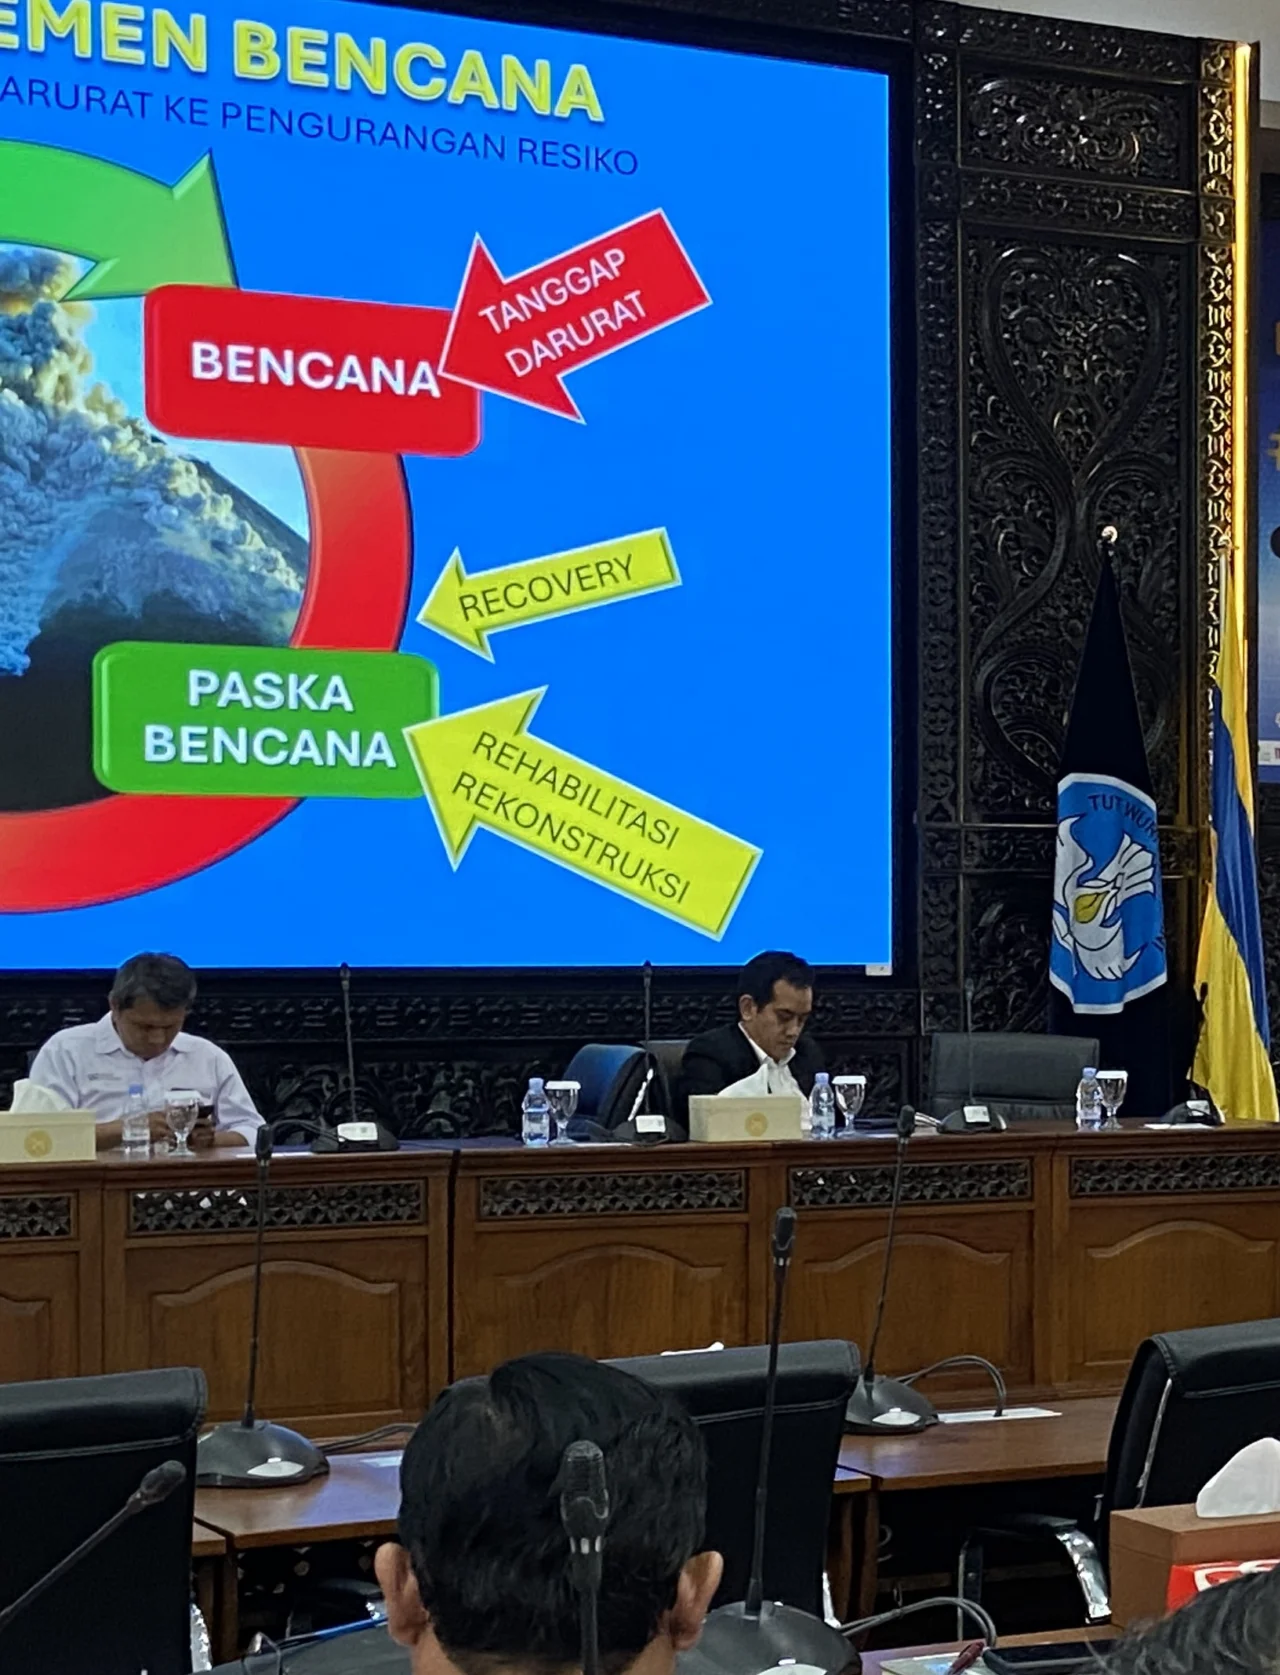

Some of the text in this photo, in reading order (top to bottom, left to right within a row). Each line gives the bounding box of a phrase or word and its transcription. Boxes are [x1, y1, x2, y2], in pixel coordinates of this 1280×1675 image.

[233, 19, 605, 122] BENCANA
[0, 76, 639, 176] ARURAT KE PENGURANGAN RESIKO
[478, 248, 626, 335] TANGGAP
[504, 290, 646, 378] DARURAT
[192, 341, 441, 399] BENCANA
[458, 553, 633, 622] RECOVERY
[189, 669, 354, 712] PASKA
[144, 724, 396, 768] BENCANA
[472, 730, 681, 850] REHABILITASI
[452, 771, 691, 904] REKONSTRUKSI
